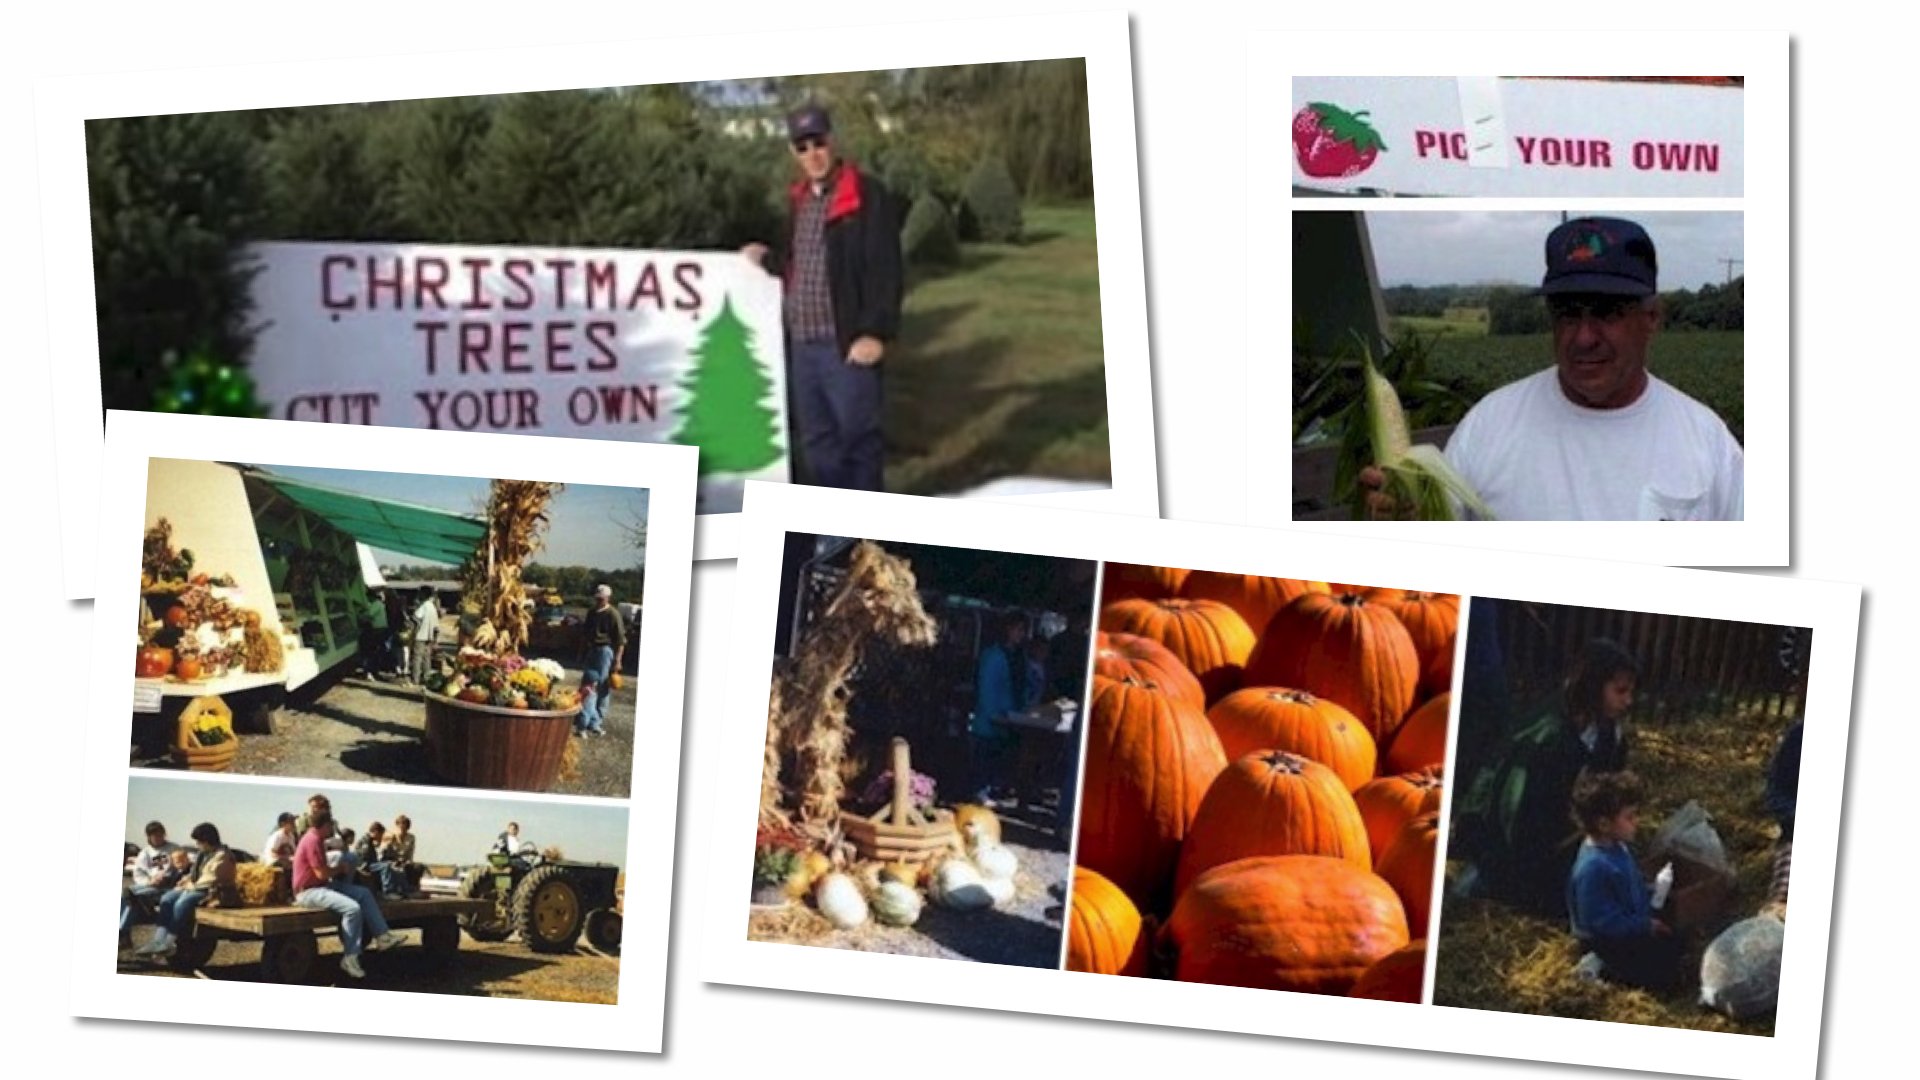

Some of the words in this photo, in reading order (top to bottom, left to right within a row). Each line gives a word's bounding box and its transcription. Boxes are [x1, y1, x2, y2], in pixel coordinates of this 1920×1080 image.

[1414, 129, 1470, 161] PIC
[1515, 135, 1613, 169] YOUR
[1632, 141, 1720, 172] OWN
[320, 254, 704, 312] CHRISTMAS
[414, 321, 620, 374] TREES
[413, 390, 541, 430] YOUR
[569, 385, 660, 426] OWN
